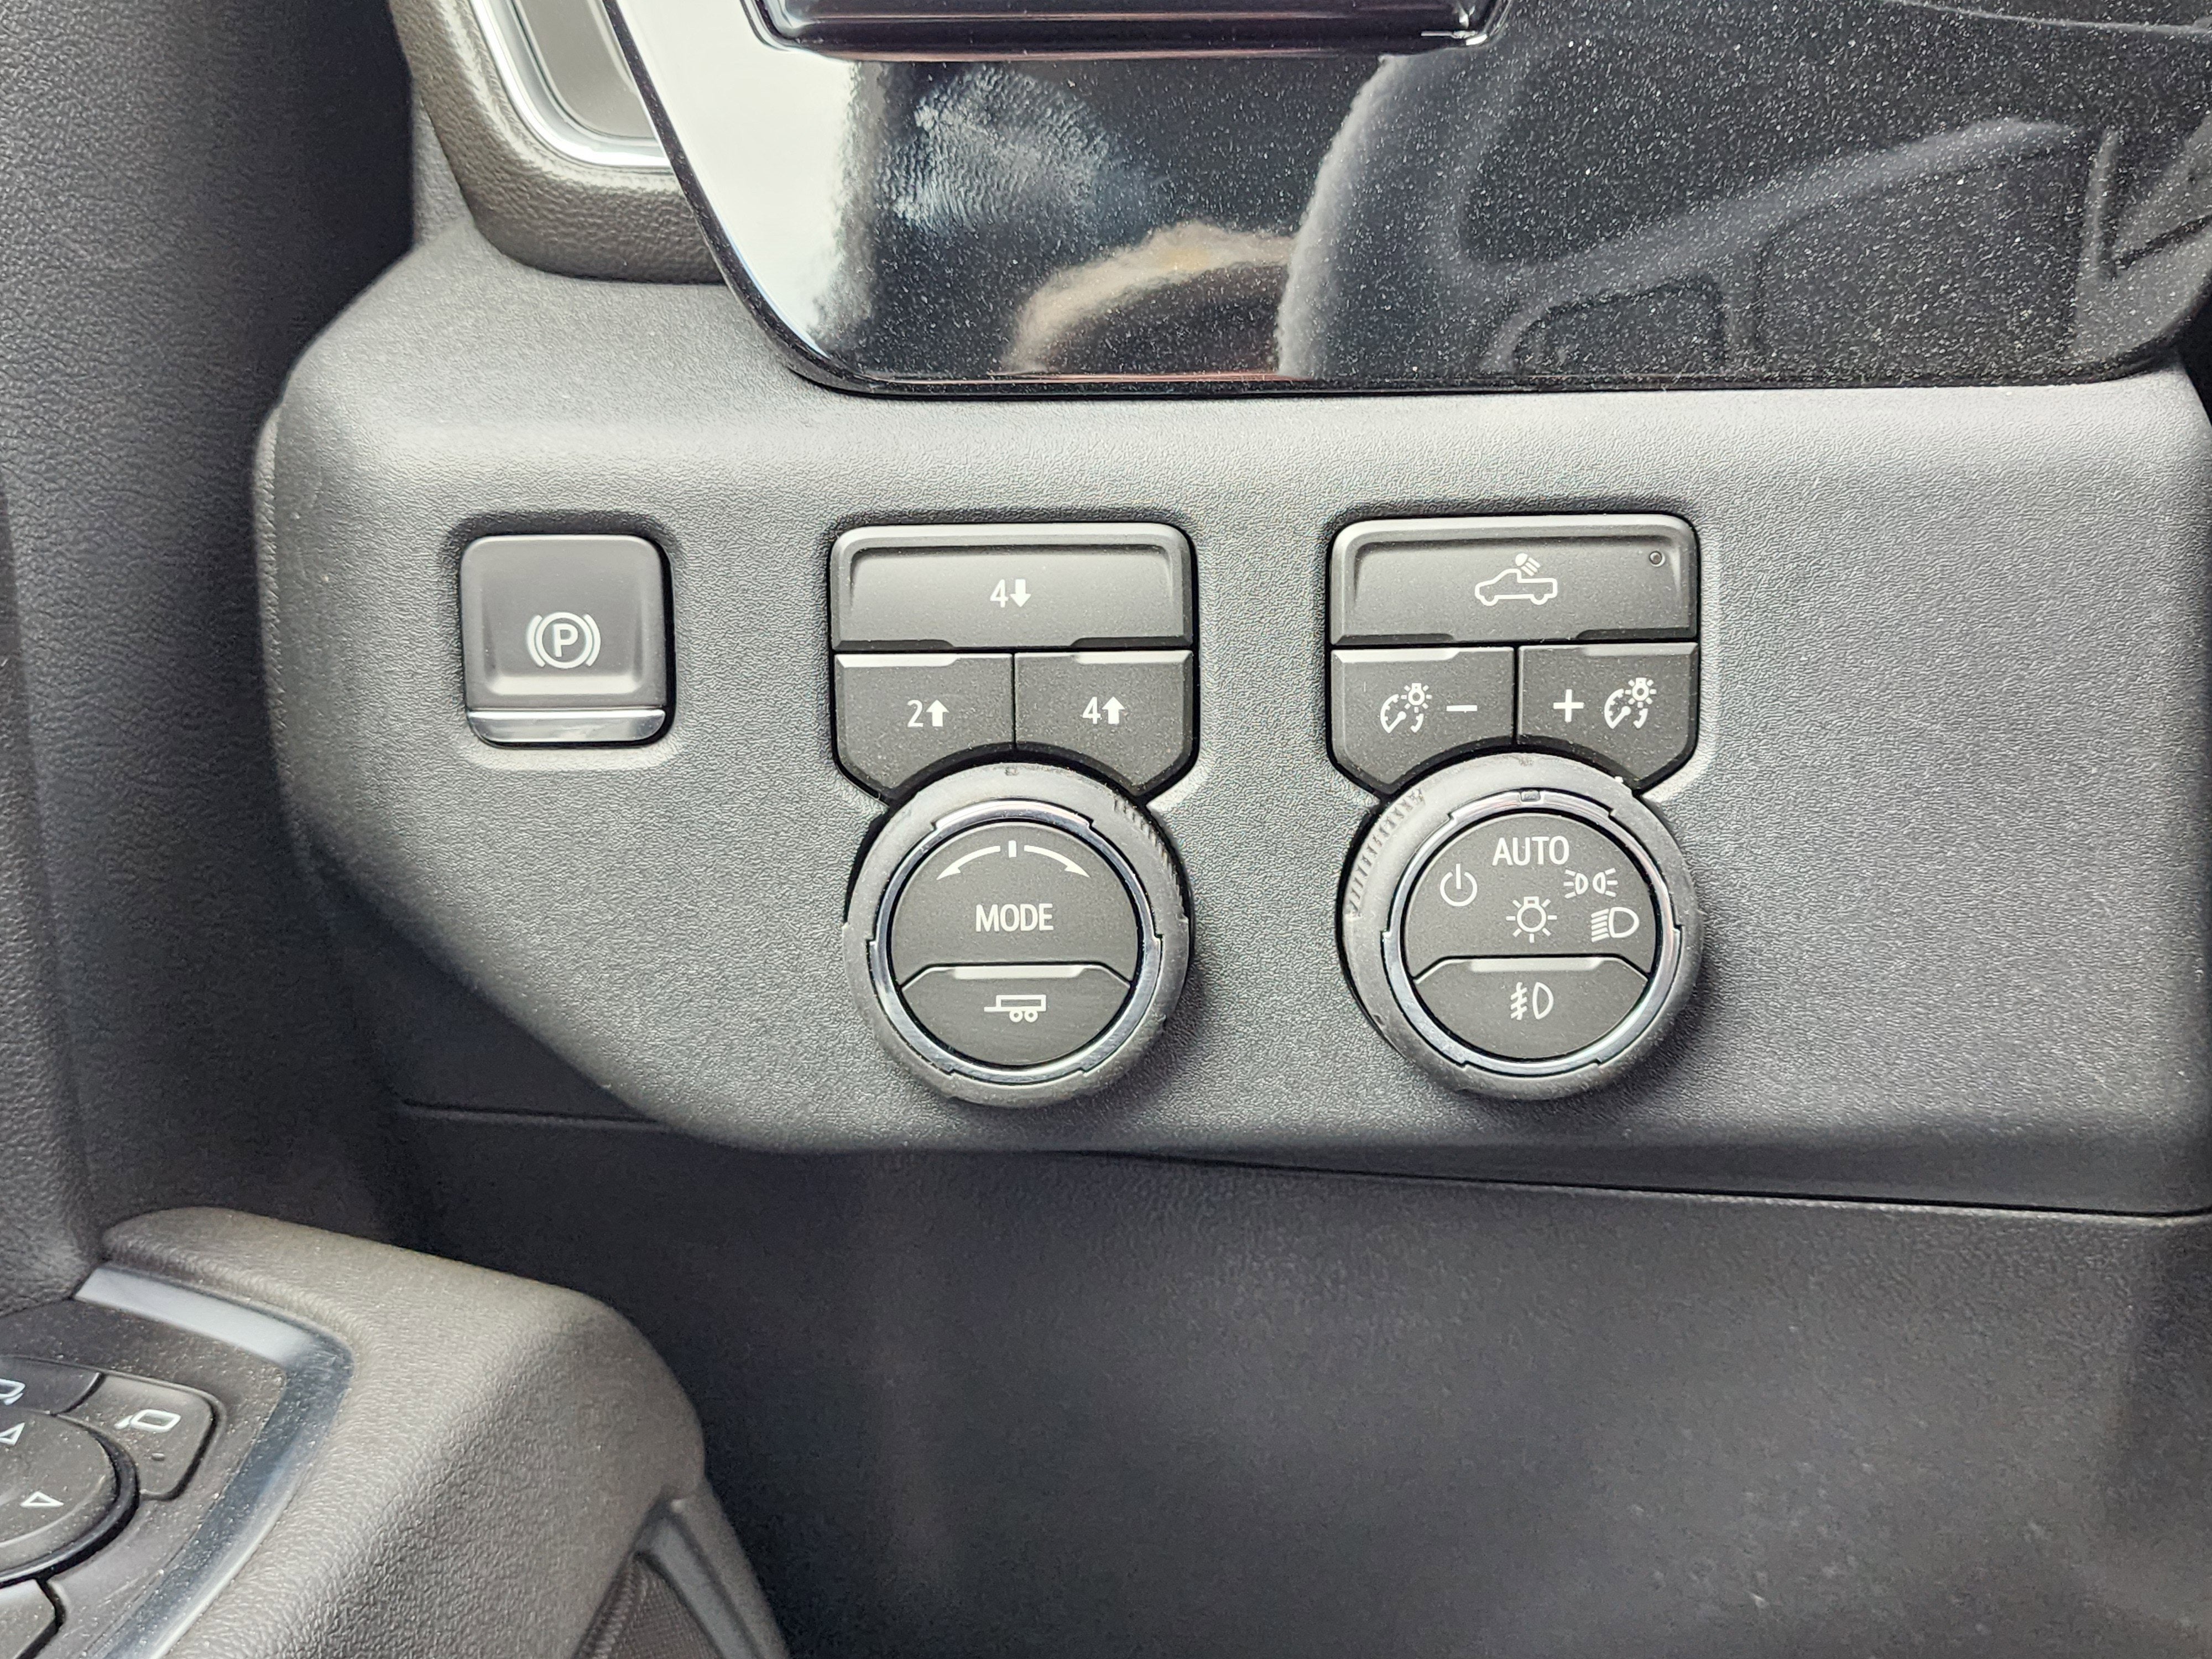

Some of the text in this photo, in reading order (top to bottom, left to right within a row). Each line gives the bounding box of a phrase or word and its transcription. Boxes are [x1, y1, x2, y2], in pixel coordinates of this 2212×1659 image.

[990, 579, 1008, 608] 4
[553, 623, 579, 658] P
[907, 700, 924, 727] 2
[1082, 696, 1101, 724] 4
[1492, 836, 1570, 867] AUTO
[975, 904, 1053, 932] MODE
